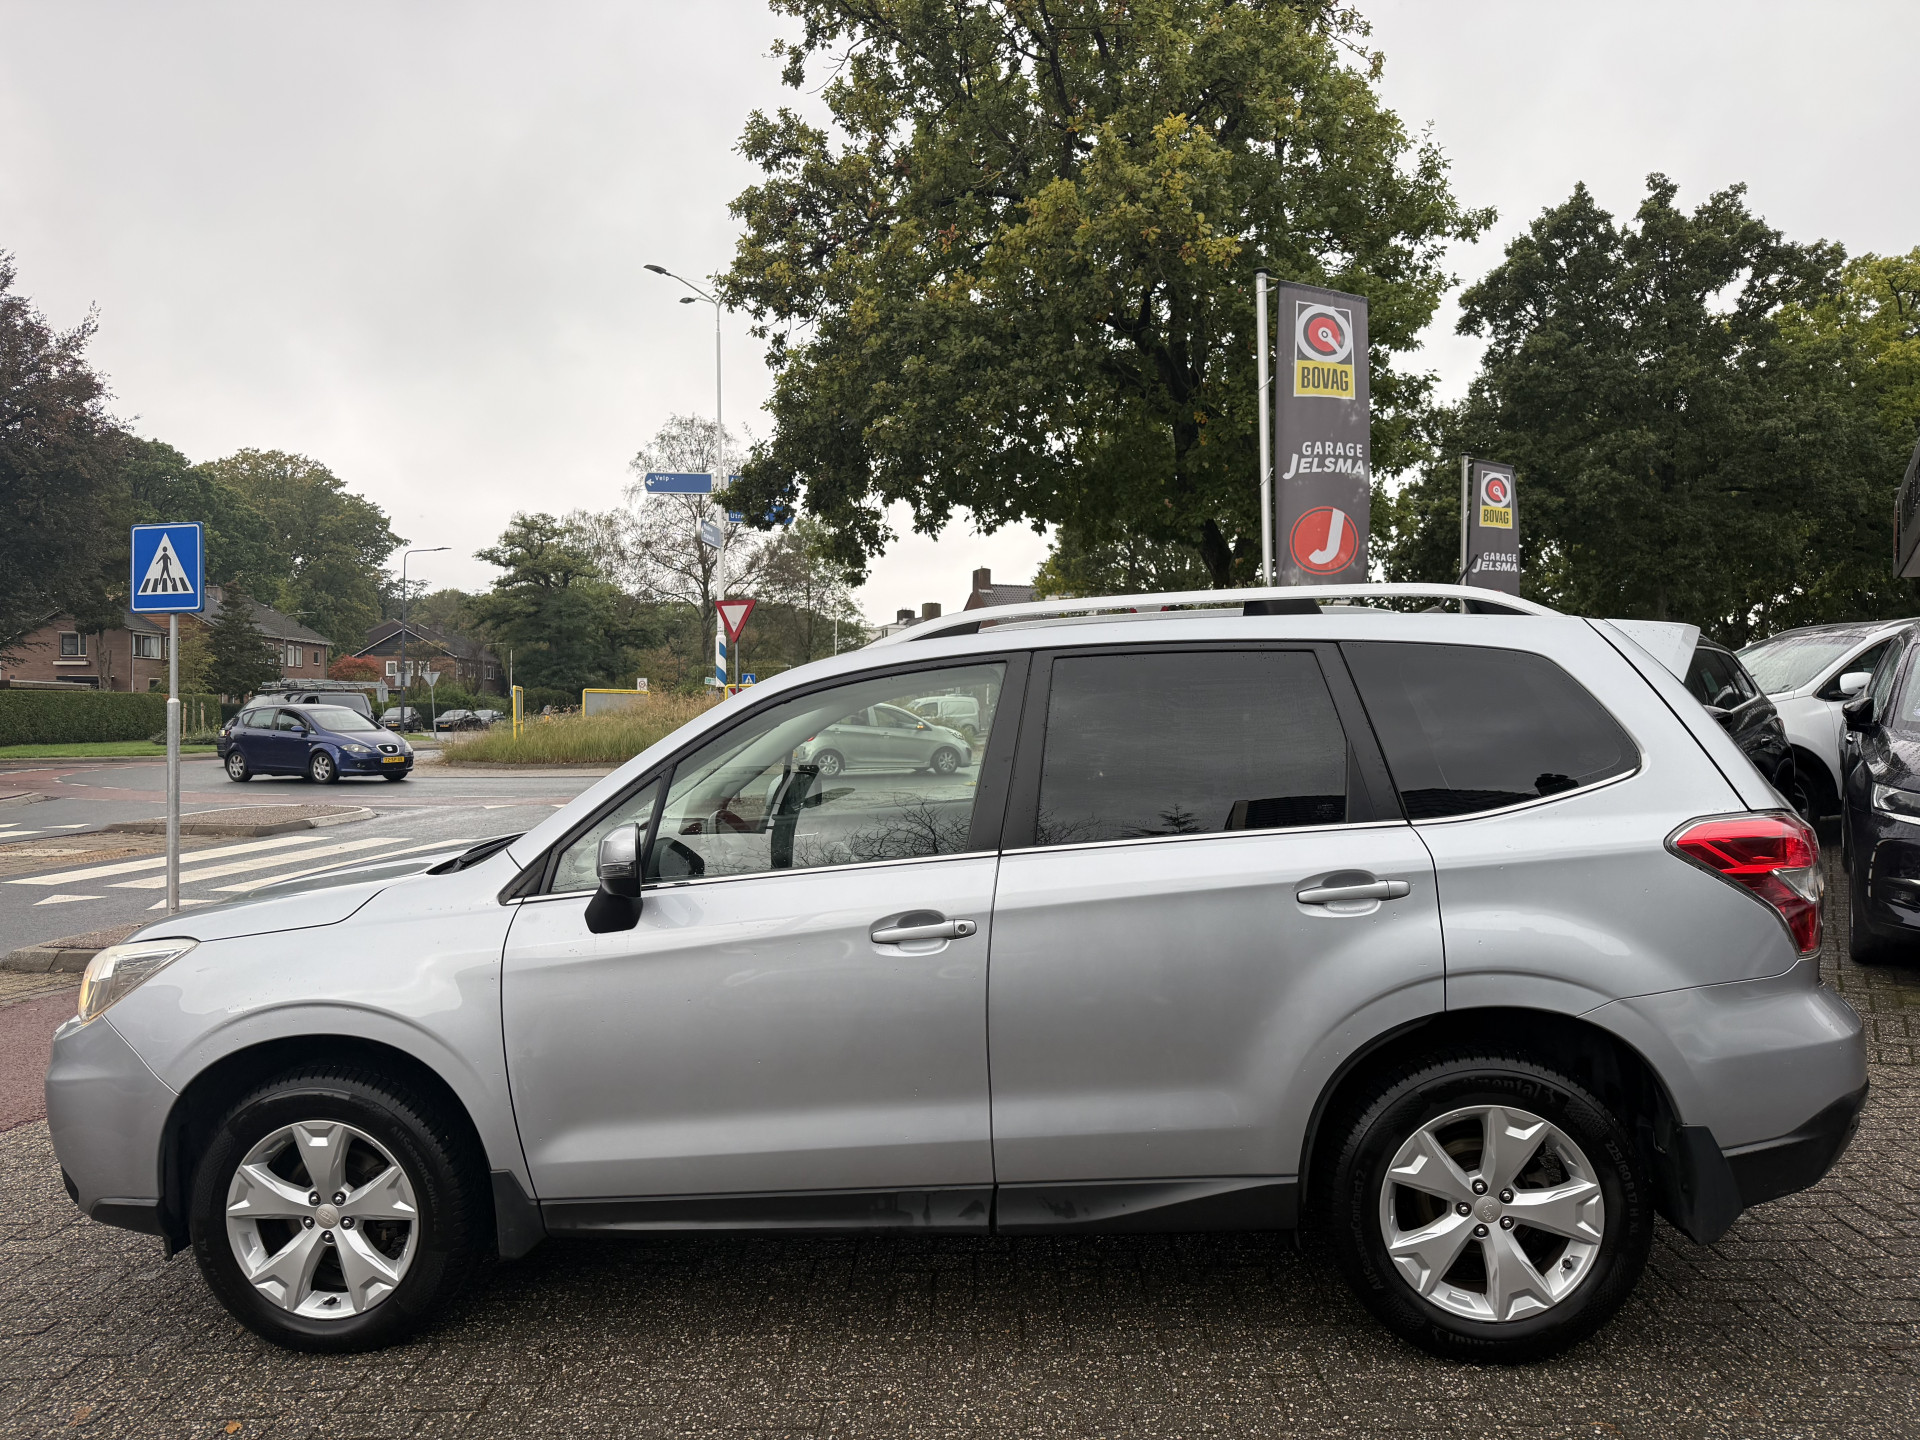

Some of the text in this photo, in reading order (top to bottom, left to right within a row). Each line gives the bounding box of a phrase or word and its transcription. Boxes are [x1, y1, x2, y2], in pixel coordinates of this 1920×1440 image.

[1301, 366, 1349, 392] BOVAG
[1302, 441, 1363, 458] GARAGE
[1282, 453, 1365, 480] JELSMA
[1483, 509, 1509, 524] BOVAG
[1483, 552, 1517, 563] GARAGE
[1471, 558, 1518, 574] JELSMA
